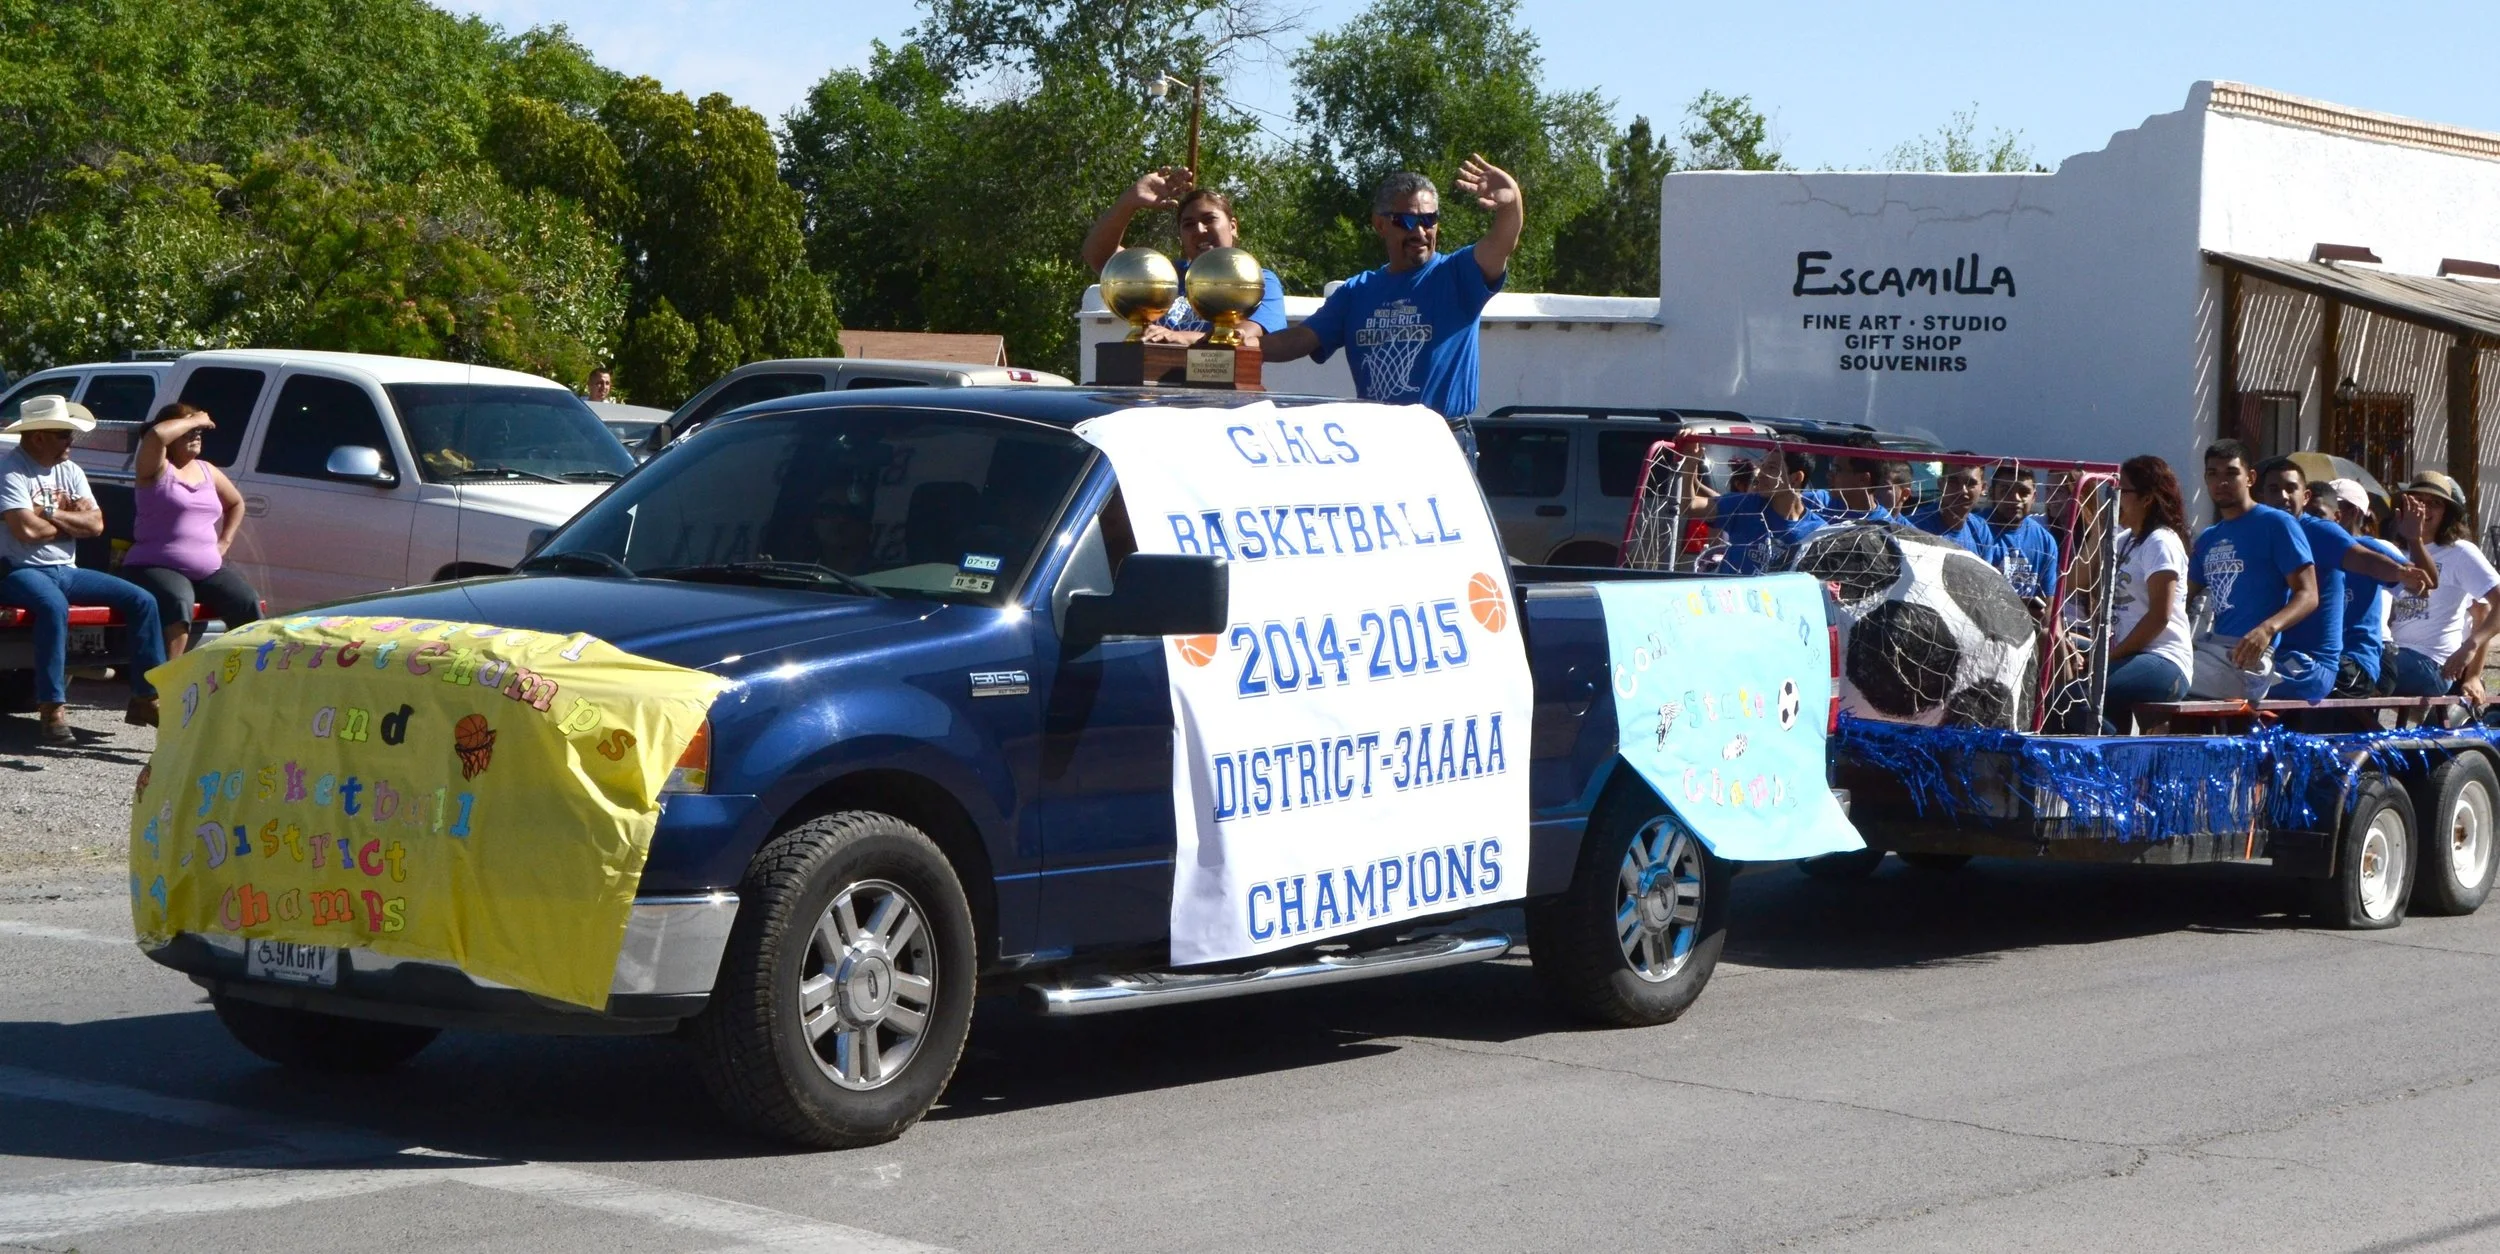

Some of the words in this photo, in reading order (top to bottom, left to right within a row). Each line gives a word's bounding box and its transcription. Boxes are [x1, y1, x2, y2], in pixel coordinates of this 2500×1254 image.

[1365, 313, 1422, 329] BI-DISRICT
[1802, 314, 1851, 330] FINE
[1859, 315, 1902, 331] ART
[1923, 315, 2008, 332] STUDIO
[1845, 334, 1895, 350] GIFT
[1903, 335, 1962, 351] SHOP
[1839, 355, 1968, 372] SOUVENIRS
[1165, 495, 1465, 563] BASKETBALL
[1228, 598, 1471, 699] 2014-2015
[312, 703, 415, 746] and
[1213, 713, 1507, 822] DISTRICT-3AAAA
[1247, 837, 1503, 943] CHAMPIONS
